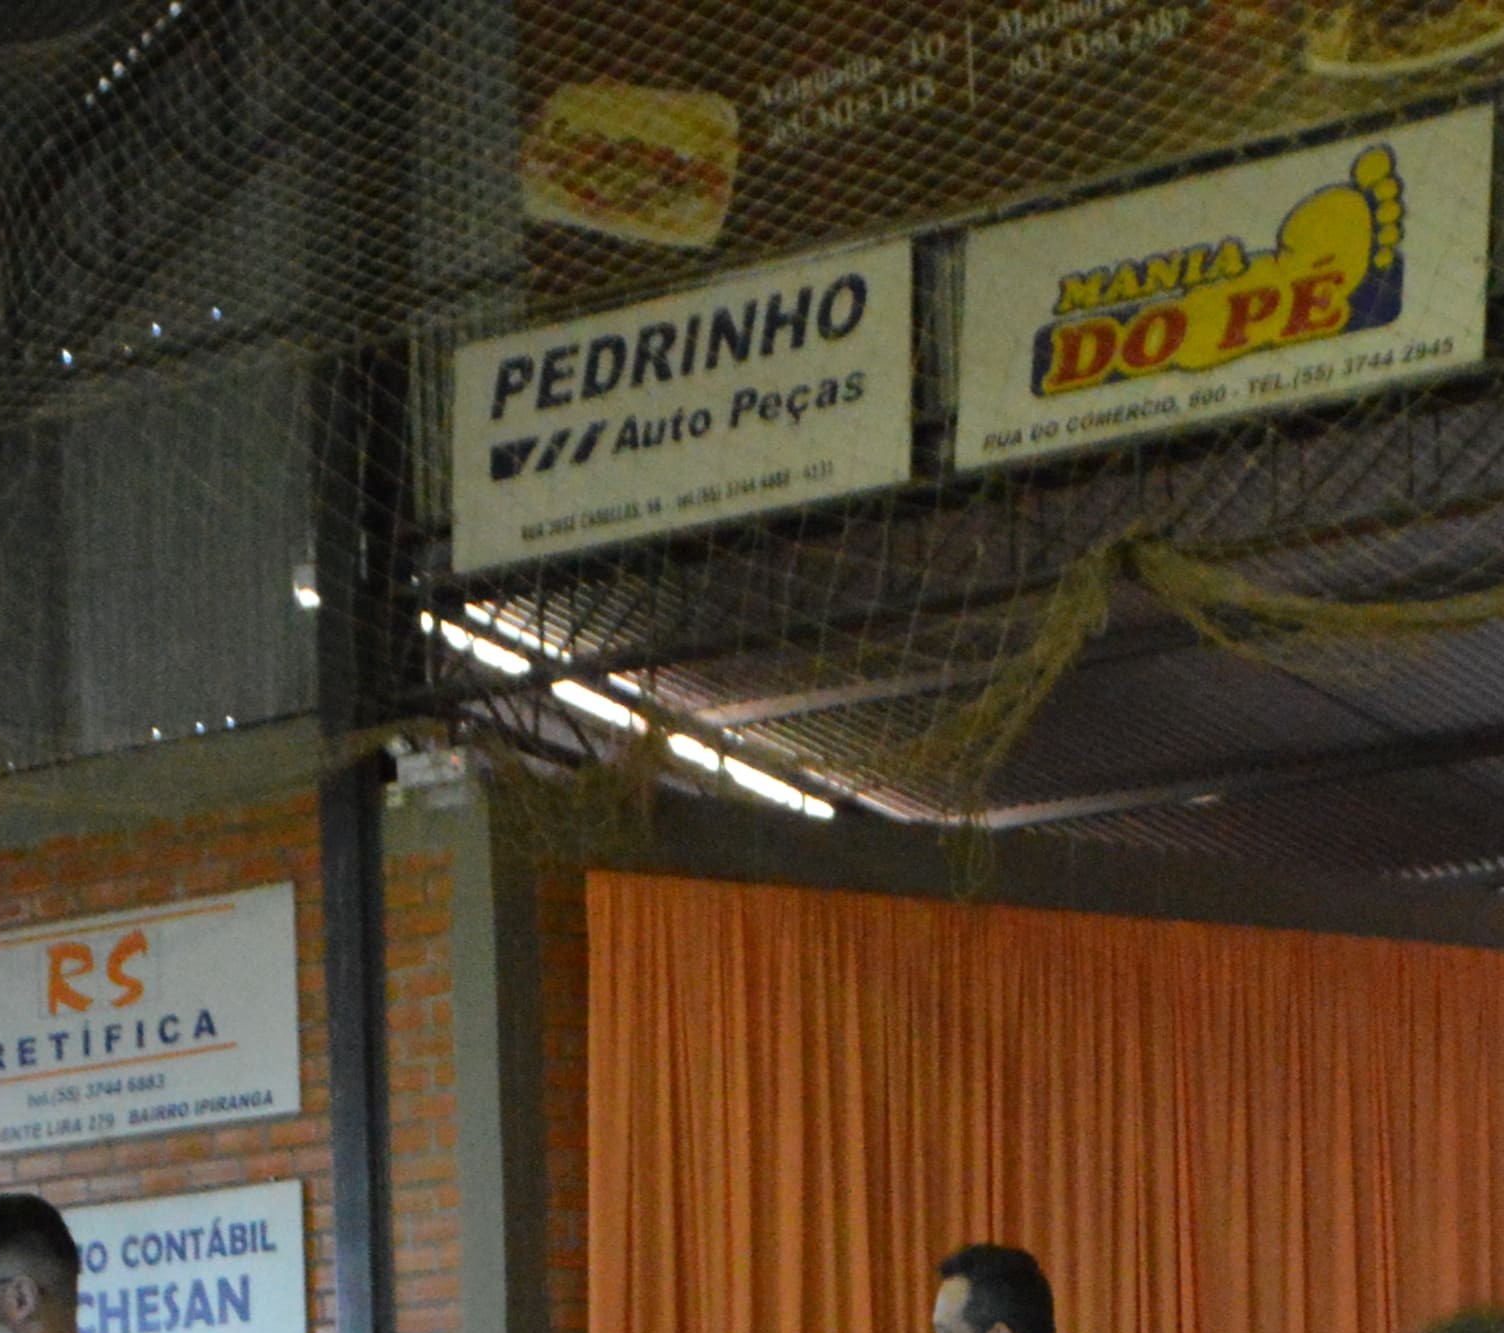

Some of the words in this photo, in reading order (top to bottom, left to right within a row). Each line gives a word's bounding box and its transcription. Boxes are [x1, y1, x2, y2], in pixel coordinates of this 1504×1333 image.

[1053, 236, 1249, 316] MANIA
[490, 271, 868, 421] PEDRINHO
[1048, 306, 1188, 388] DO
[1217, 254, 1347, 351] PÉ
[612, 406, 712, 455] Auto
[728, 370, 866, 428] Peças
[982, 428, 1023, 452] RUA
[1030, 421, 1059, 443] DO
[1342, 348, 1395, 376] 3744
[1401, 336, 1455, 364] 2945
[46, 929, 151, 1016] RS
[85, 1078, 124, 1101] 3744
[128, 1100, 188, 1127] BAIRRO
[194, 1089, 274, 1116] IPIRANGA
[121, 1216, 278, 1269] CONTÁBIL
